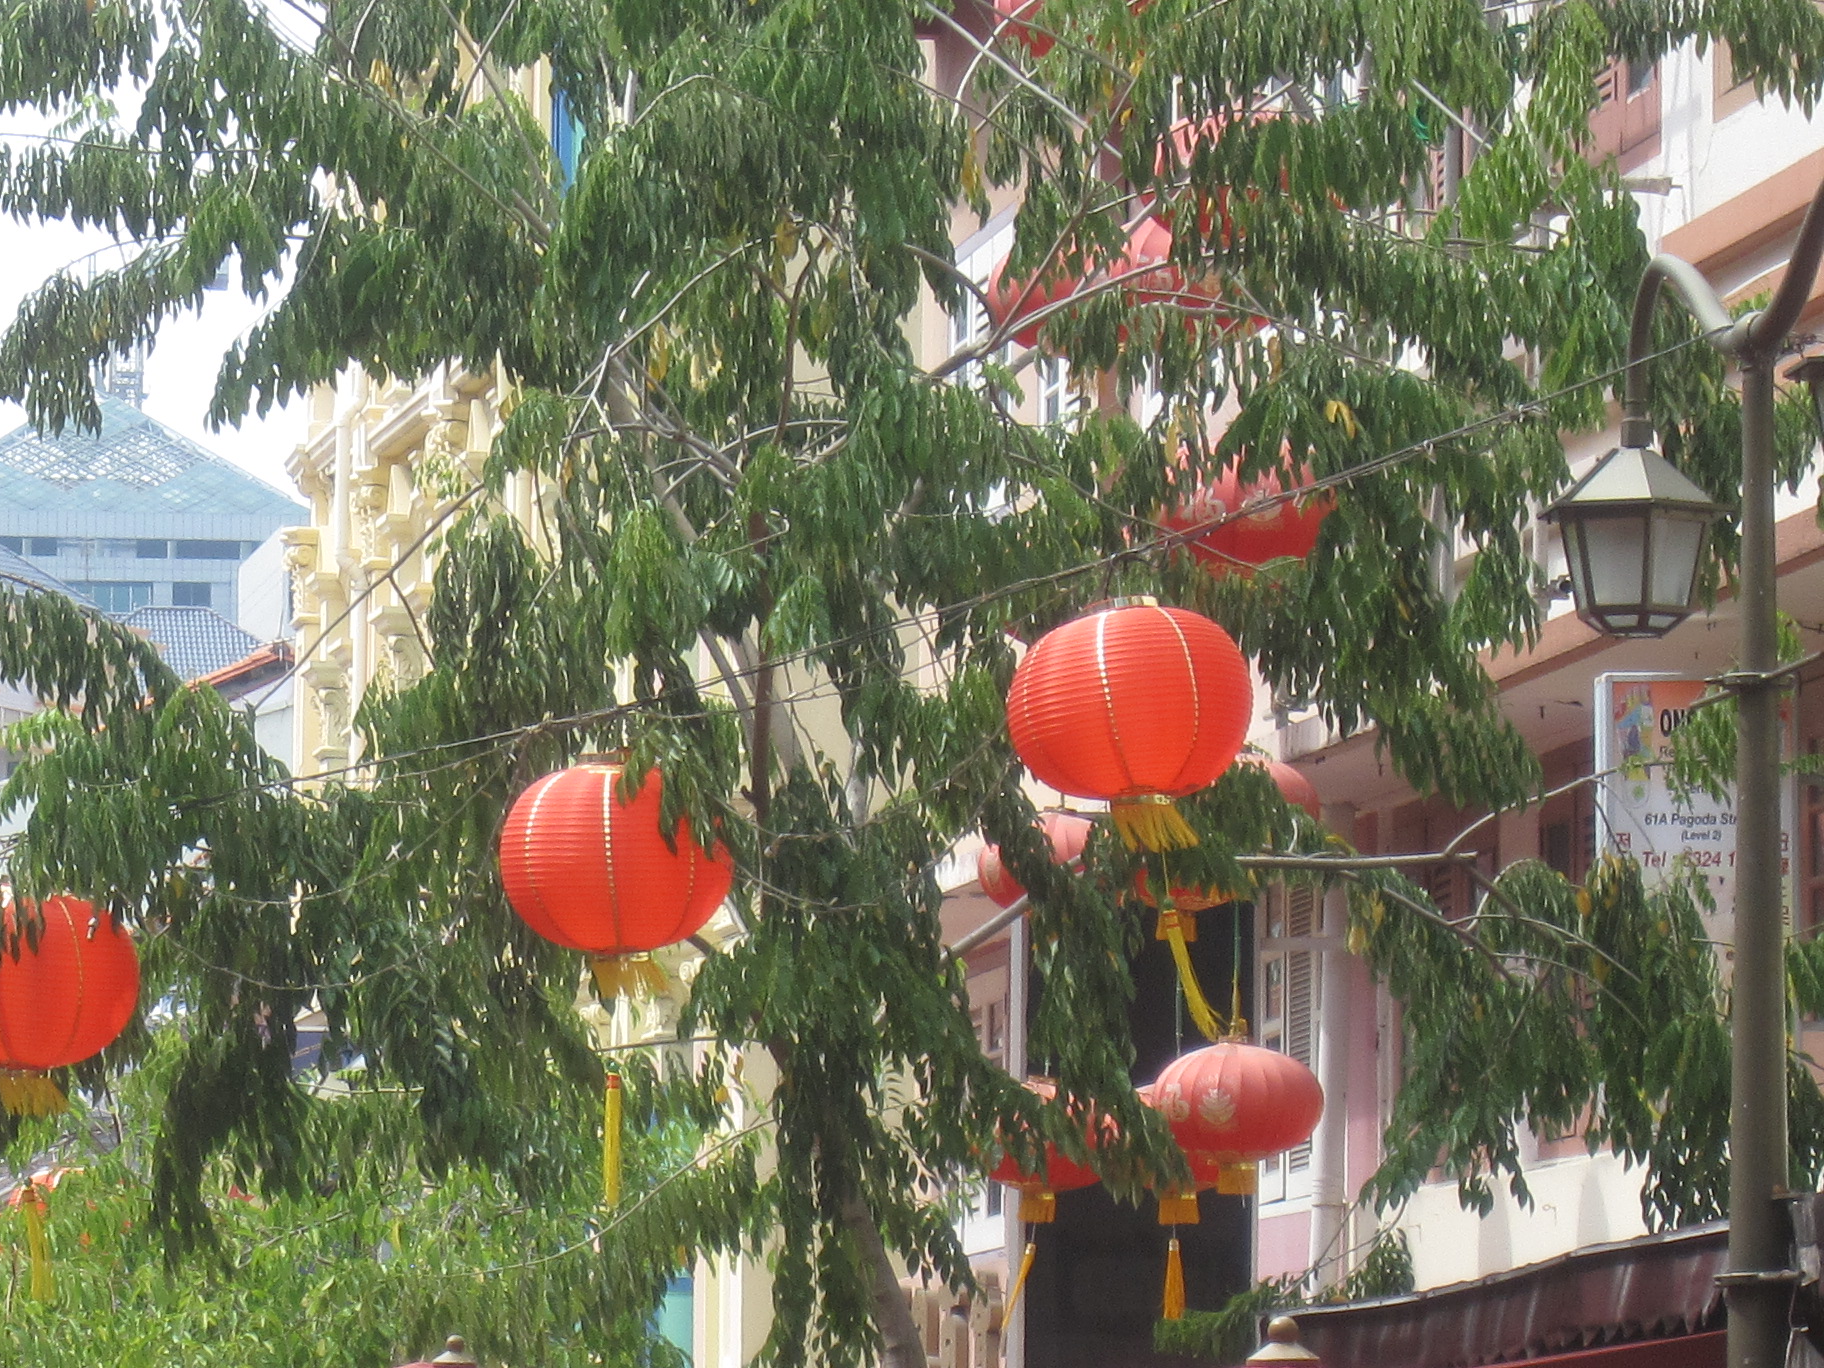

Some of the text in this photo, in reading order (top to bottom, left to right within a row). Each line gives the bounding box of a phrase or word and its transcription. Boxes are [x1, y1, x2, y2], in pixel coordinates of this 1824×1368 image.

[1671, 812, 1717, 829] Pagoda
[1720, 812, 1737, 826] Str
[1643, 851, 1666, 868] Tel
